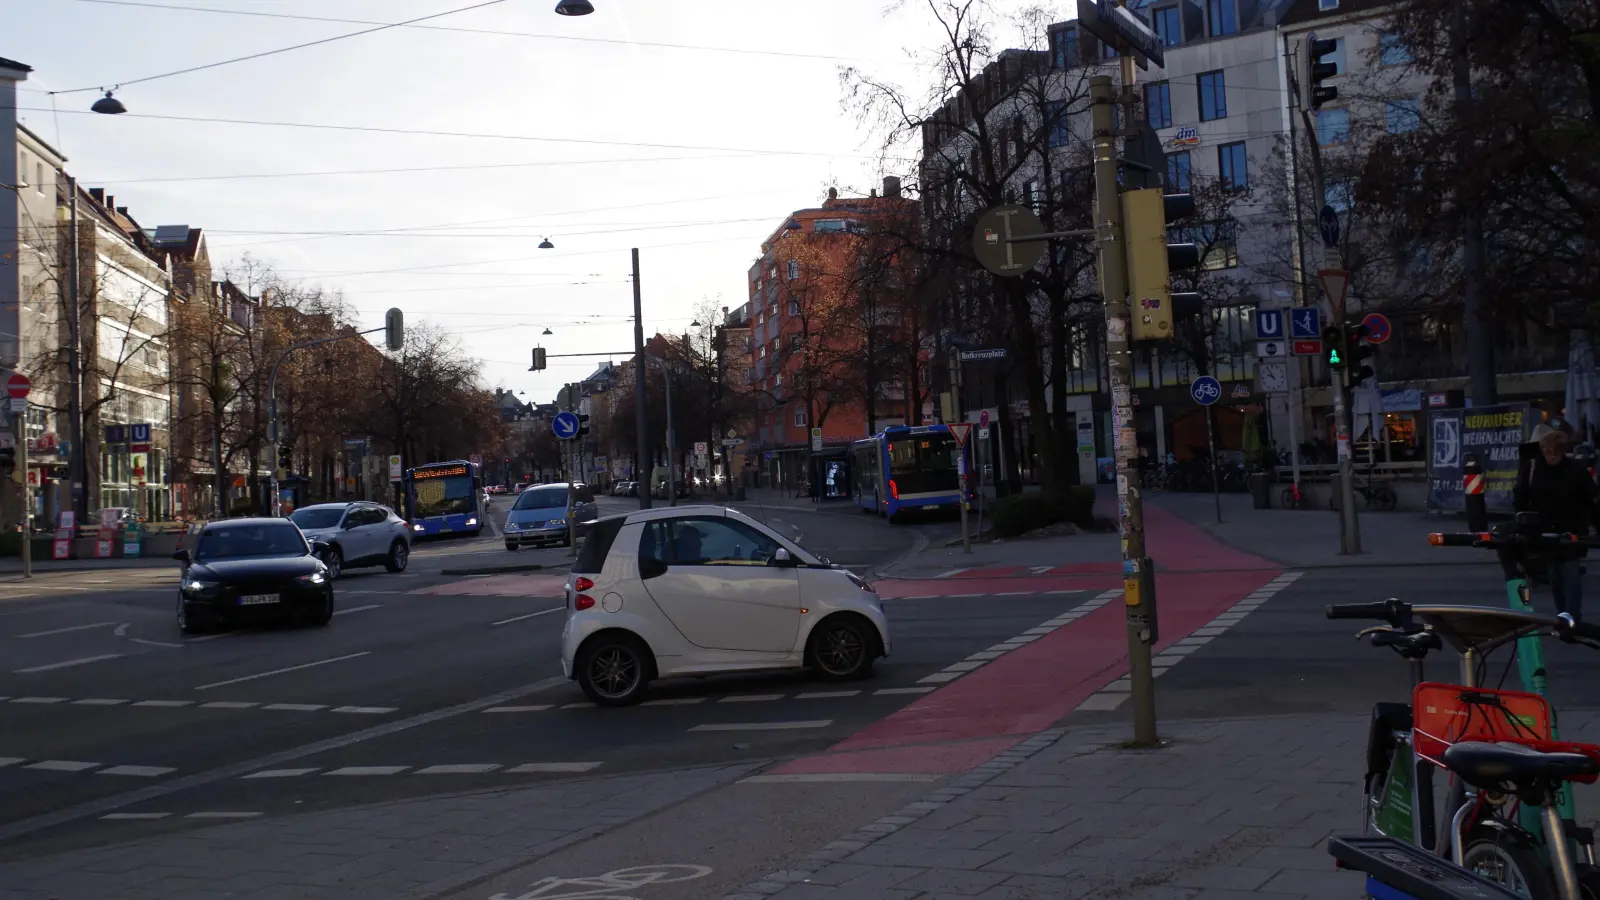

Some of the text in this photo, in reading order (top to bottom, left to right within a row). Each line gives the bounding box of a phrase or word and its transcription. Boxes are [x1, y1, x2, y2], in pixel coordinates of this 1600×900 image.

[1176, 127, 1196, 140] dm
[1261, 313, 1277, 334] U
[961, 350, 1005, 360] Rotkreuzplatz
[135, 426, 146, 440] U
[1463, 429, 1522, 446] WEIHNACHTS
